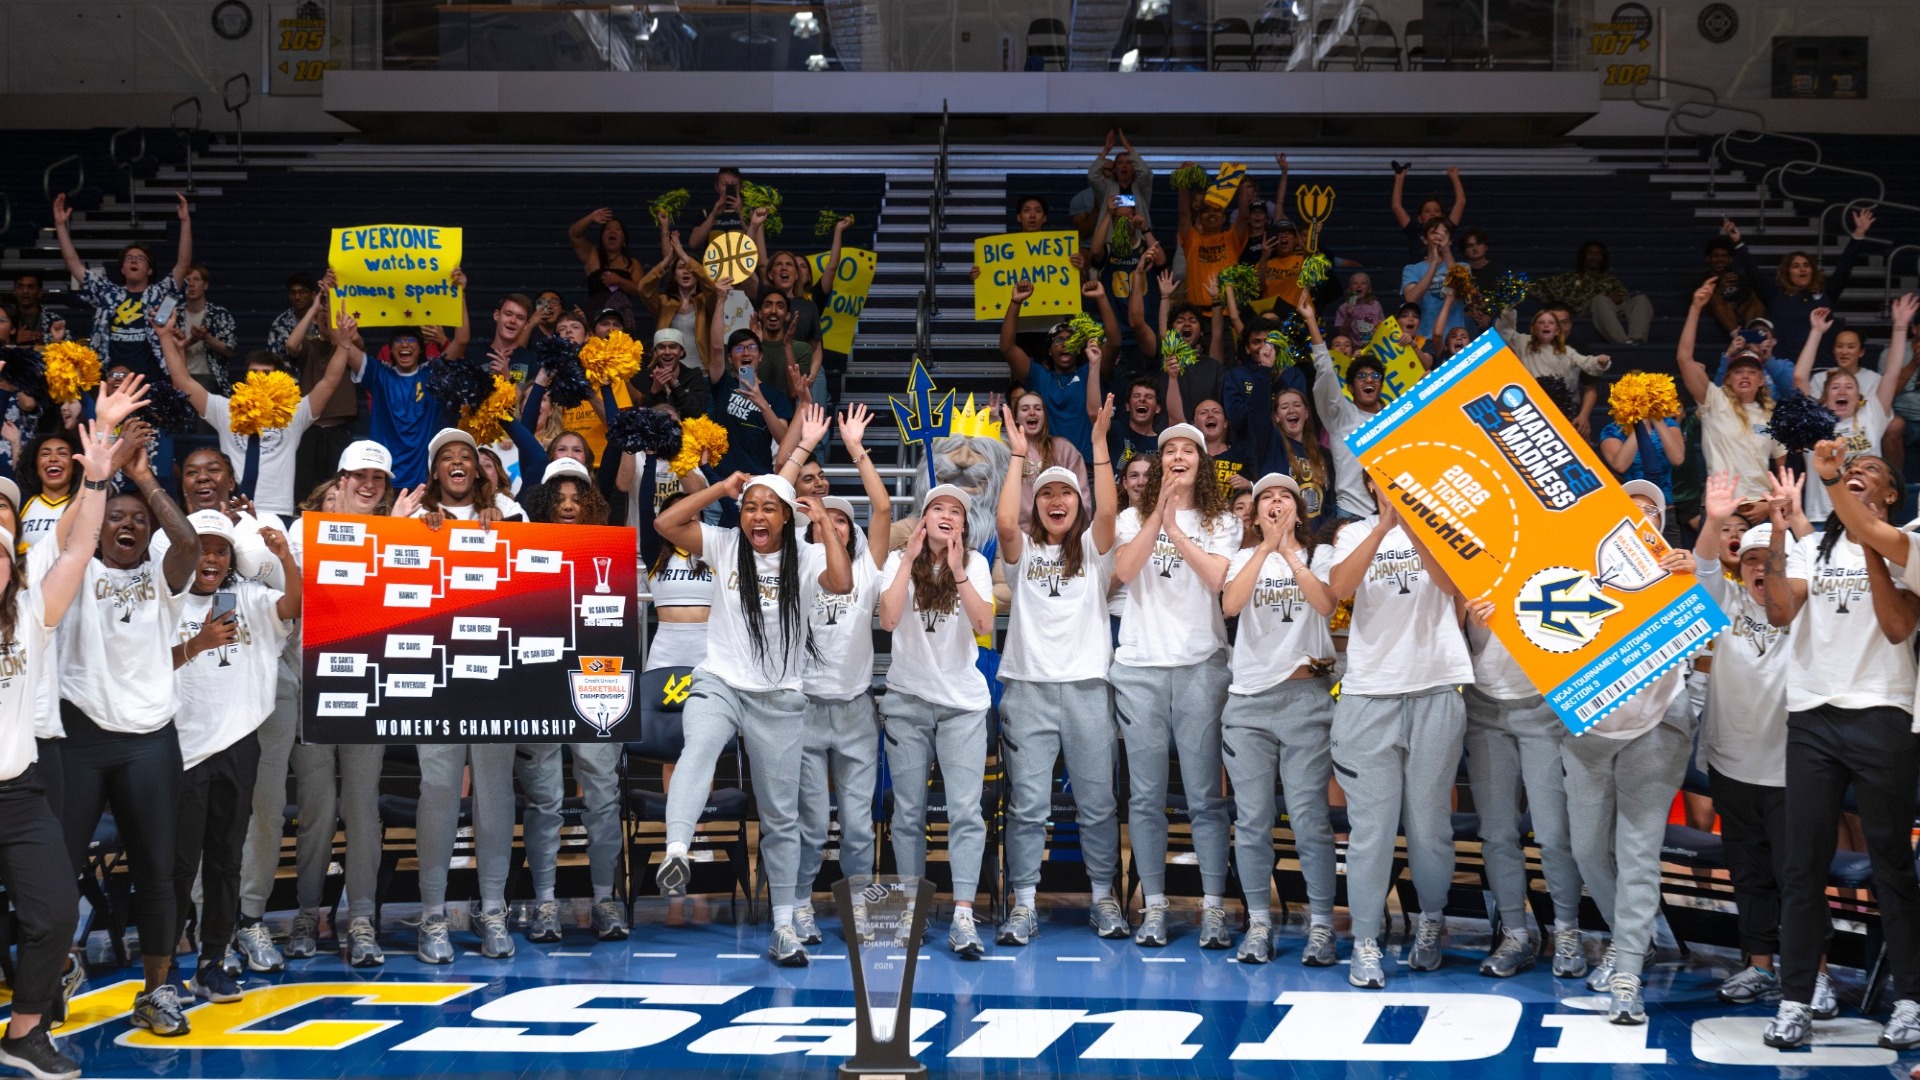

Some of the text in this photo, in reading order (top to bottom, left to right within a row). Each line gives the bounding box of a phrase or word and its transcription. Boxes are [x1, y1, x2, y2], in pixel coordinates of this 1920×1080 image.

[278, 30, 325, 51] 105
[1588, 34, 1635, 55] 107
[341, 227, 442, 251] EVERYONE
[984, 236, 1075, 263] BIG WEST
[364, 253, 439, 271] watches
[993, 265, 1070, 286] CHAMPS
[334, 278, 458, 304] womens sports
[727, 402, 750, 420] RISE
[1355, 400, 1415, 448] #MARCHMADNESS
[1510, 403, 1574, 468] MARCH
[1498, 423, 1576, 508] MADNESS
[1442, 464, 1491, 506] 2026
[1430, 477, 1477, 519] TICKET
[1387, 471, 1486, 560] PUNCHED
[21, 518, 60, 533] TRIT
[329, 524, 354, 534] CAL STATE
[328, 533, 355, 542] FULLERTON
[461, 536, 485, 545] UC IRVINE
[394, 558, 421, 566] FULLERTON
[395, 549, 420, 558] CAL STATE
[1253, 588, 1306, 608] CHAMPIO
[588, 605, 619, 614] UC SAN DIEGO
[1673, 610, 1694, 628] SEAT
[459, 624, 492, 633] UC SAN DIEGO
[398, 642, 420, 650] UC DAVIS
[523, 648, 555, 659] UC SAN DIEGO
[1552, 593, 1700, 704] NCAA TOURNAMENT AUTOMATIC QUALIFIER
[1621, 642, 1652, 666] ROW 15
[330, 656, 354, 664] UC SANTA
[330, 664, 354, 673] BARBARA
[466, 664, 488, 674] UC DAVIS
[394, 680, 426, 689] UC RIVERSIDE
[325, 700, 358, 709] UC RIVERSIDE
[1560, 684, 1594, 711] SECTION
[376, 719, 577, 736] WOMEN'S CHAMPIONSHIP
[889, 883, 906, 891] THE
[873, 962, 894, 970] 2026
[389, 983, 1204, 1060] San
